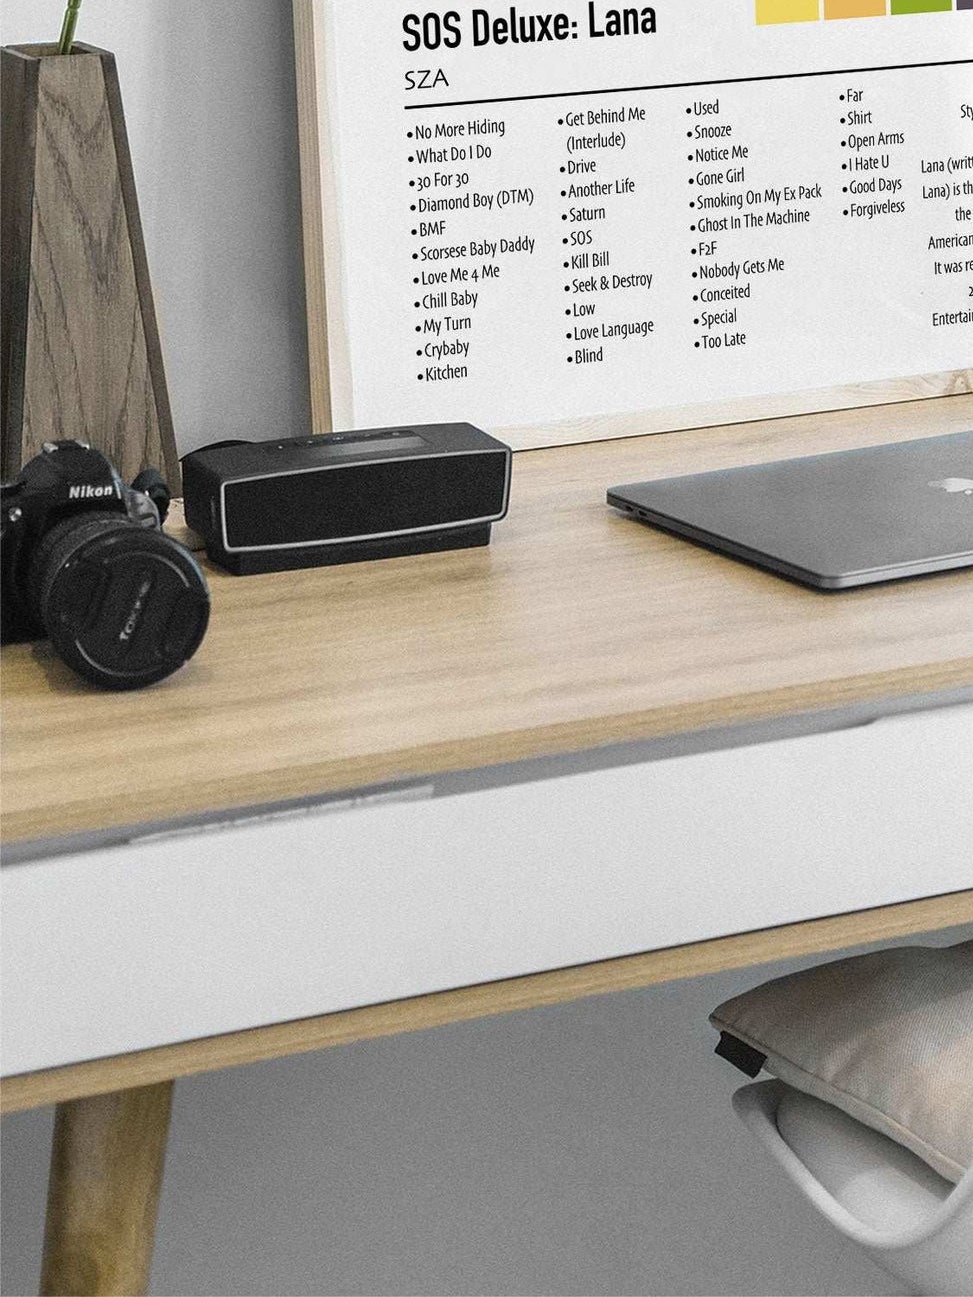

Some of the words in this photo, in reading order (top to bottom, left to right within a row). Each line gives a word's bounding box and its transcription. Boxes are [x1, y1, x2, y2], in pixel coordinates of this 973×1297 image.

[402, 10, 462, 52] SOS
[472, 6, 578, 47] Deluxe:
[588, 1, 657, 38] Lana
[404, 68, 450, 91] SZA
[847, 88, 864, 103] Far
[565, 112, 585, 127] Get
[587, 106, 625, 125] Behind
[628, 107, 646, 122] Me
[693, 98, 719, 116] Used
[847, 110, 873, 126] Shirt
[415, 125, 432, 140] No
[434, 123, 465, 138] More
[467, 118, 505, 137] Hiding
[694, 124, 732, 140] Snooze
[566, 131, 626, 155] (Interlude)
[848, 134, 875, 152] Open
[877, 132, 905, 146] Arms
[415, 147, 449, 164] What
[450, 146, 467, 161] Do
[469, 145, 473, 160] I
[476, 144, 492, 159] Do
[695, 146, 729, 163] Notice
[731, 145, 749, 159] Me
[849, 158, 852, 172] I
[855, 156, 879, 171] Hate
[881, 154, 890, 169] U
[567, 159, 596, 175] Drive
[696, 171, 724, 186] Gone
[725, 166, 745, 183] Girl
[921, 159, 945, 174] Lana
[417, 176, 431, 192] 30
[434, 172, 453, 187] For
[455, 172, 469, 188] 30
[568, 180, 613, 199] Another
[615, 177, 635, 194] Life
[849, 177, 876, 195] Good
[878, 177, 902, 194] Days
[922, 183, 951, 200] Lana)
[953, 182, 961, 196] is
[418, 192, 470, 213] Diamond
[473, 193, 494, 210] Boy
[496, 188, 534, 209] (DTM)
[697, 192, 743, 210] Smoking
[746, 190, 762, 205] On
[764, 188, 781, 206] My
[783, 186, 796, 201] Ex
[798, 183, 823, 199] Pack
[569, 207, 606, 223] Saturn
[850, 199, 906, 220] Forgiveless
[954, 206, 972, 222] the
[419, 220, 446, 237] BMF
[697, 217, 728, 233] Ghost
[730, 216, 741, 230] In
[743, 212, 764, 228] The
[765, 208, 810, 226] Machine
[570, 229, 593, 246] SOS
[420, 245, 467, 262] Scorsese
[469, 239, 497, 258] Baby
[500, 235, 535, 254] Daddy
[698, 240, 717, 256] F2F
[571, 253, 589, 270] Kill
[592, 251, 610, 268] Bill
[699, 261, 740, 280] Nobody
[742, 260, 766, 275] Gets
[767, 258, 785, 272] Me
[934, 261, 942, 275] It
[943, 261, 963, 274] was
[421, 271, 448, 286] Love
[450, 267, 469, 283] Me
[471, 268, 479, 283] 4
[481, 264, 500, 279] Me
[572, 276, 598, 294] Seek
[600, 275, 610, 291] &
[612, 273, 653, 290] Destroy
[422, 291, 447, 310] Chill
[450, 289, 478, 309] Baby
[700, 282, 751, 303] Conceited
[573, 302, 596, 317] Low
[701, 307, 737, 330] Special
[423, 318, 442, 337] My
[443, 316, 472, 331] Turn
[574, 326, 599, 341] Love
[601, 320, 654, 340] Language
[424, 338, 470, 361] Crybaby
[701, 335, 722, 349] Too
[724, 332, 746, 347] Late
[575, 346, 603, 365] Blind
[425, 363, 468, 382] Kitchen
[69, 485, 113, 499] Nikon
